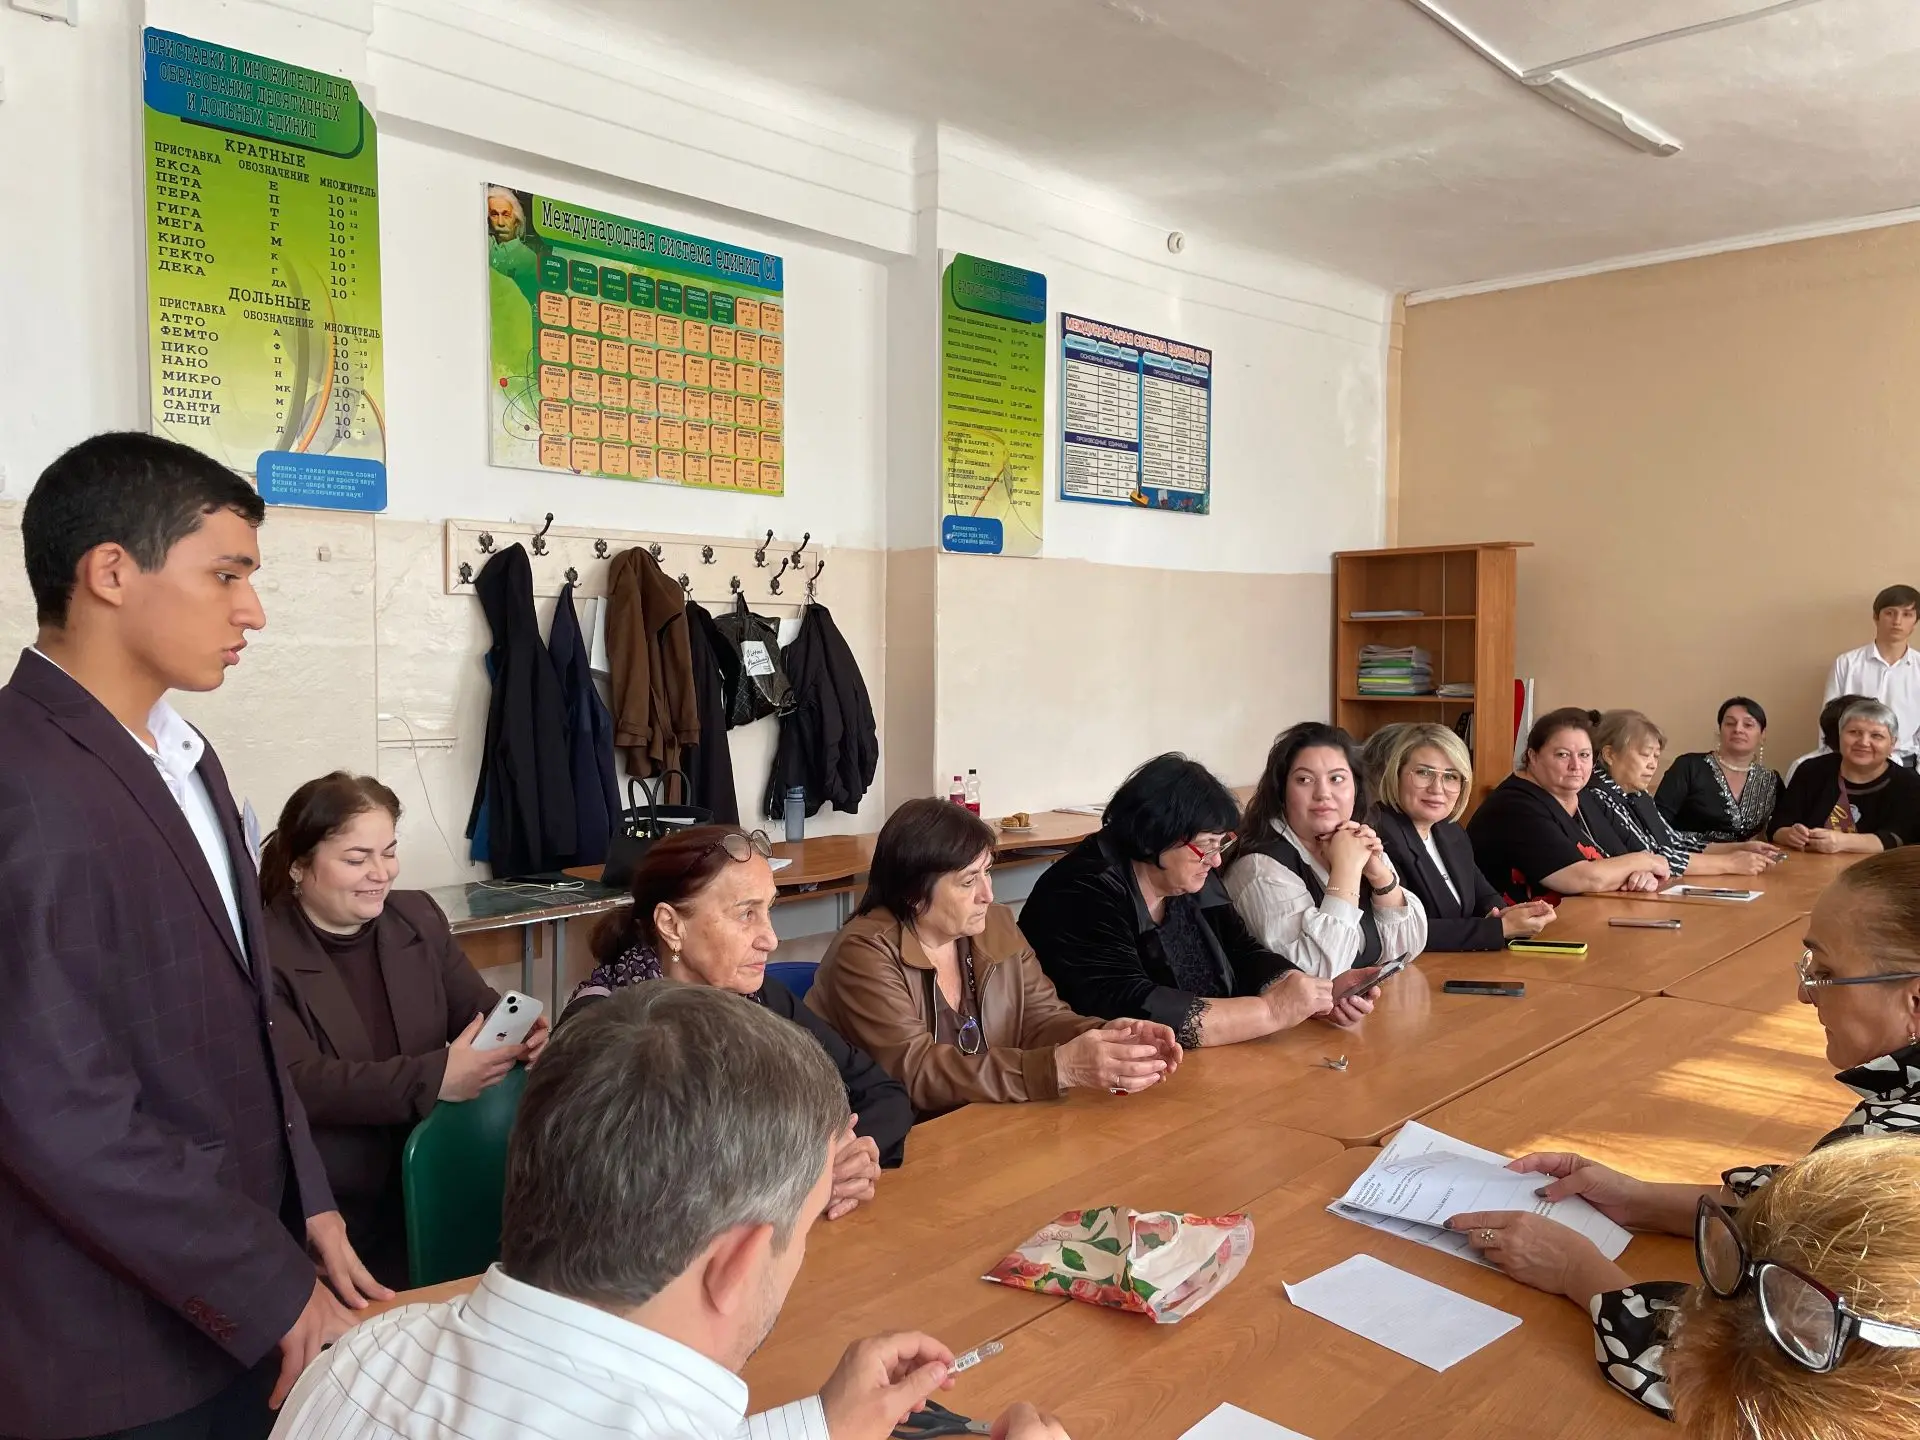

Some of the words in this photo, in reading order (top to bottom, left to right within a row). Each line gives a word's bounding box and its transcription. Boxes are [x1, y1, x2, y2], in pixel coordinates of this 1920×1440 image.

[148, 36, 226, 70] ПРИСТАВКИ
[230, 56, 239, 73] И
[244, 59, 321, 94] МНОЖИТЕЛИ
[326, 81, 350, 101] ДЛЯ
[258, 87, 340, 121] ДЕСЯТИЧНЫХ
[187, 92, 196, 111] И
[200, 96, 263, 126] ДОЛЬНЫХ
[268, 112, 317, 139] ЕДИНИЦ
[225, 139, 305, 168] КРАТНЫЕ
[155, 158, 202, 176] ЕКСА
[155, 141, 222, 164] ПРИСТАВКА
[239, 159, 309, 183] ОБОЗНАЧЕНИЕ
[320, 177, 376, 198] МНОЖИТЕЛЬ
[156, 172, 202, 189] ПЕТА
[157, 186, 201, 202] ТЕРА
[269, 194, 280, 204] П
[157, 202, 202, 218] ГИГА
[270, 208, 279, 217] Т
[157, 216, 204, 233] МЕГА
[270, 222, 279, 231] Г
[158, 232, 206, 249] КИЛО
[271, 236, 282, 246] М
[542, 201, 654, 251] Международная
[659, 236, 712, 266] система
[715, 250, 761, 281] единиц
[158, 246, 215, 264] ГЕКТО
[158, 261, 206, 276] ДЕКА
[229, 287, 311, 311] ДОЛЬНЫЕ
[159, 297, 226, 315] ПРИСТАВКА
[243, 310, 314, 329] ОБОЗНАЧЕНИЕ
[325, 322, 380, 338] МНОЖИТЕЛЬ
[160, 312, 205, 327] АТТО
[161, 326, 218, 341] ФЕМТО
[1066, 316, 1134, 346] МЕЖДУНАРОДНАЯ
[1134, 334, 1167, 353] СИСТЕМА
[1168, 342, 1195, 362] ЕДИНИЦ
[161, 341, 208, 355] ПИКО
[162, 354, 208, 368] НАНО
[162, 370, 221, 385] МИКРО
[163, 386, 212, 400] МИЛИ
[163, 400, 220, 413] САНТИ
[163, 413, 211, 426] ДЕЦИ
